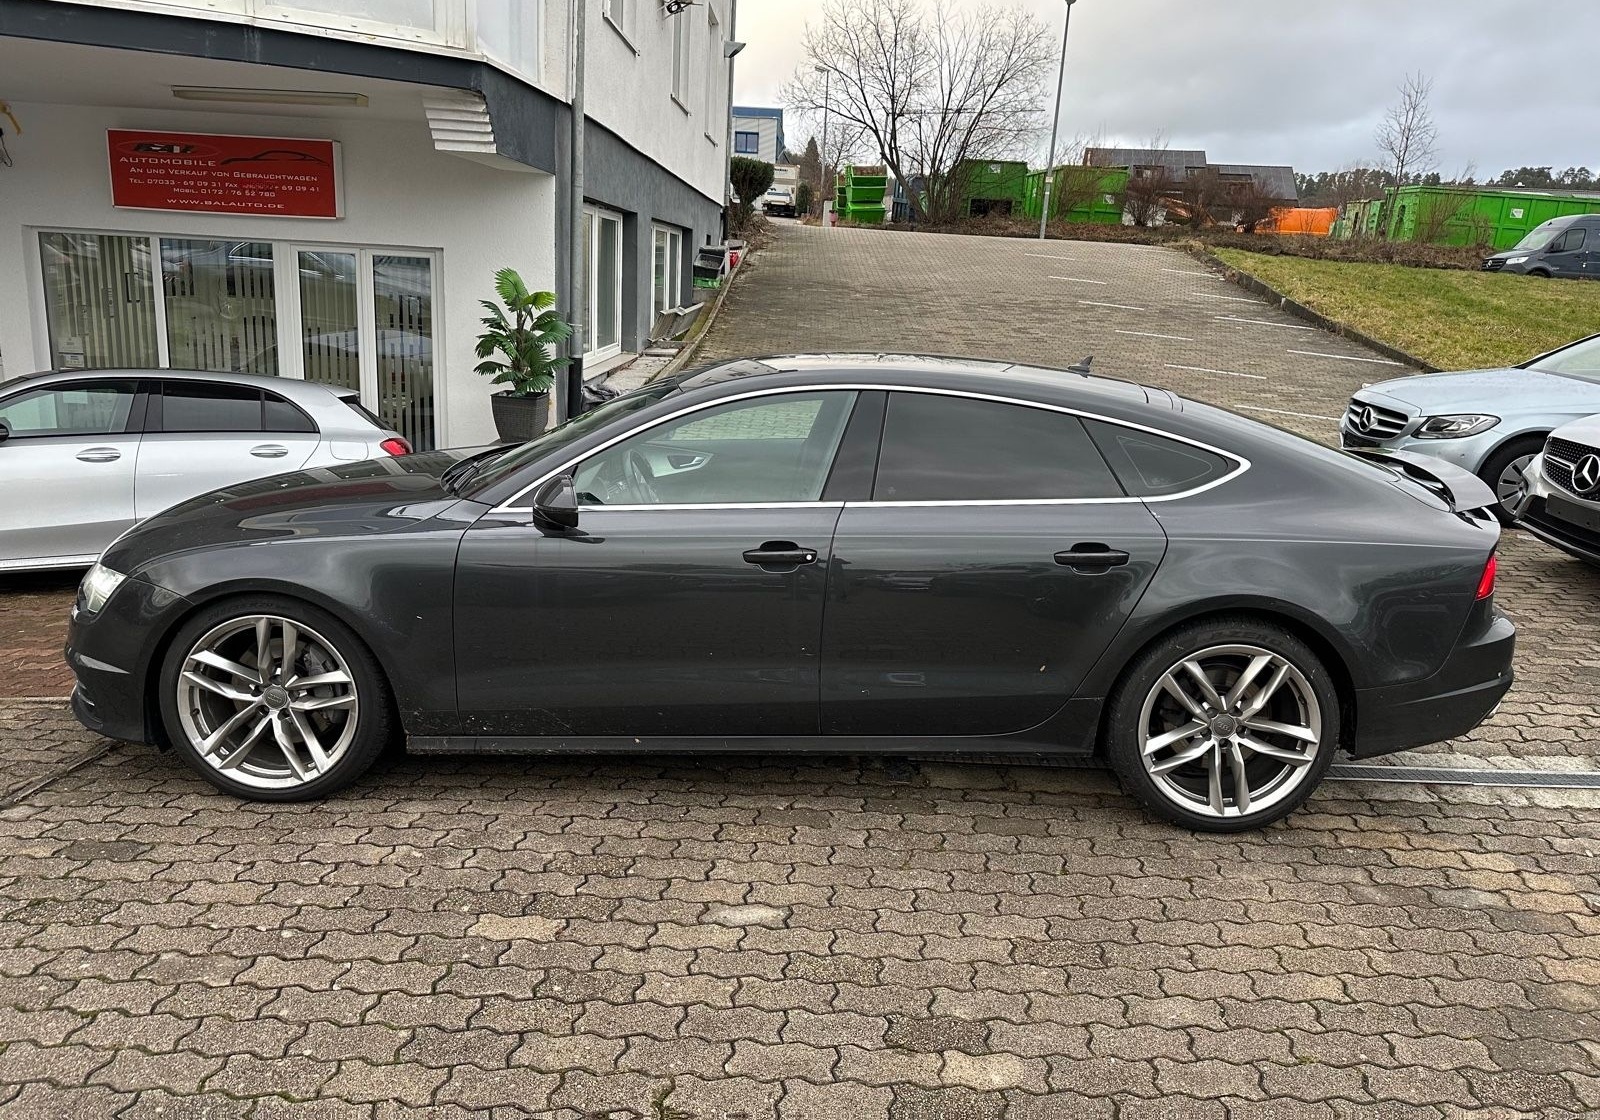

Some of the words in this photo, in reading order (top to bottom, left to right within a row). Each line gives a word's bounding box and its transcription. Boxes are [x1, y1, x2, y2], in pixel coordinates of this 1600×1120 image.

[119, 156, 216, 167] AUTOMOBILE
[168, 168, 208, 176] VERKAUF
[233, 171, 318, 182] GEBRAUCHTWAGEN
